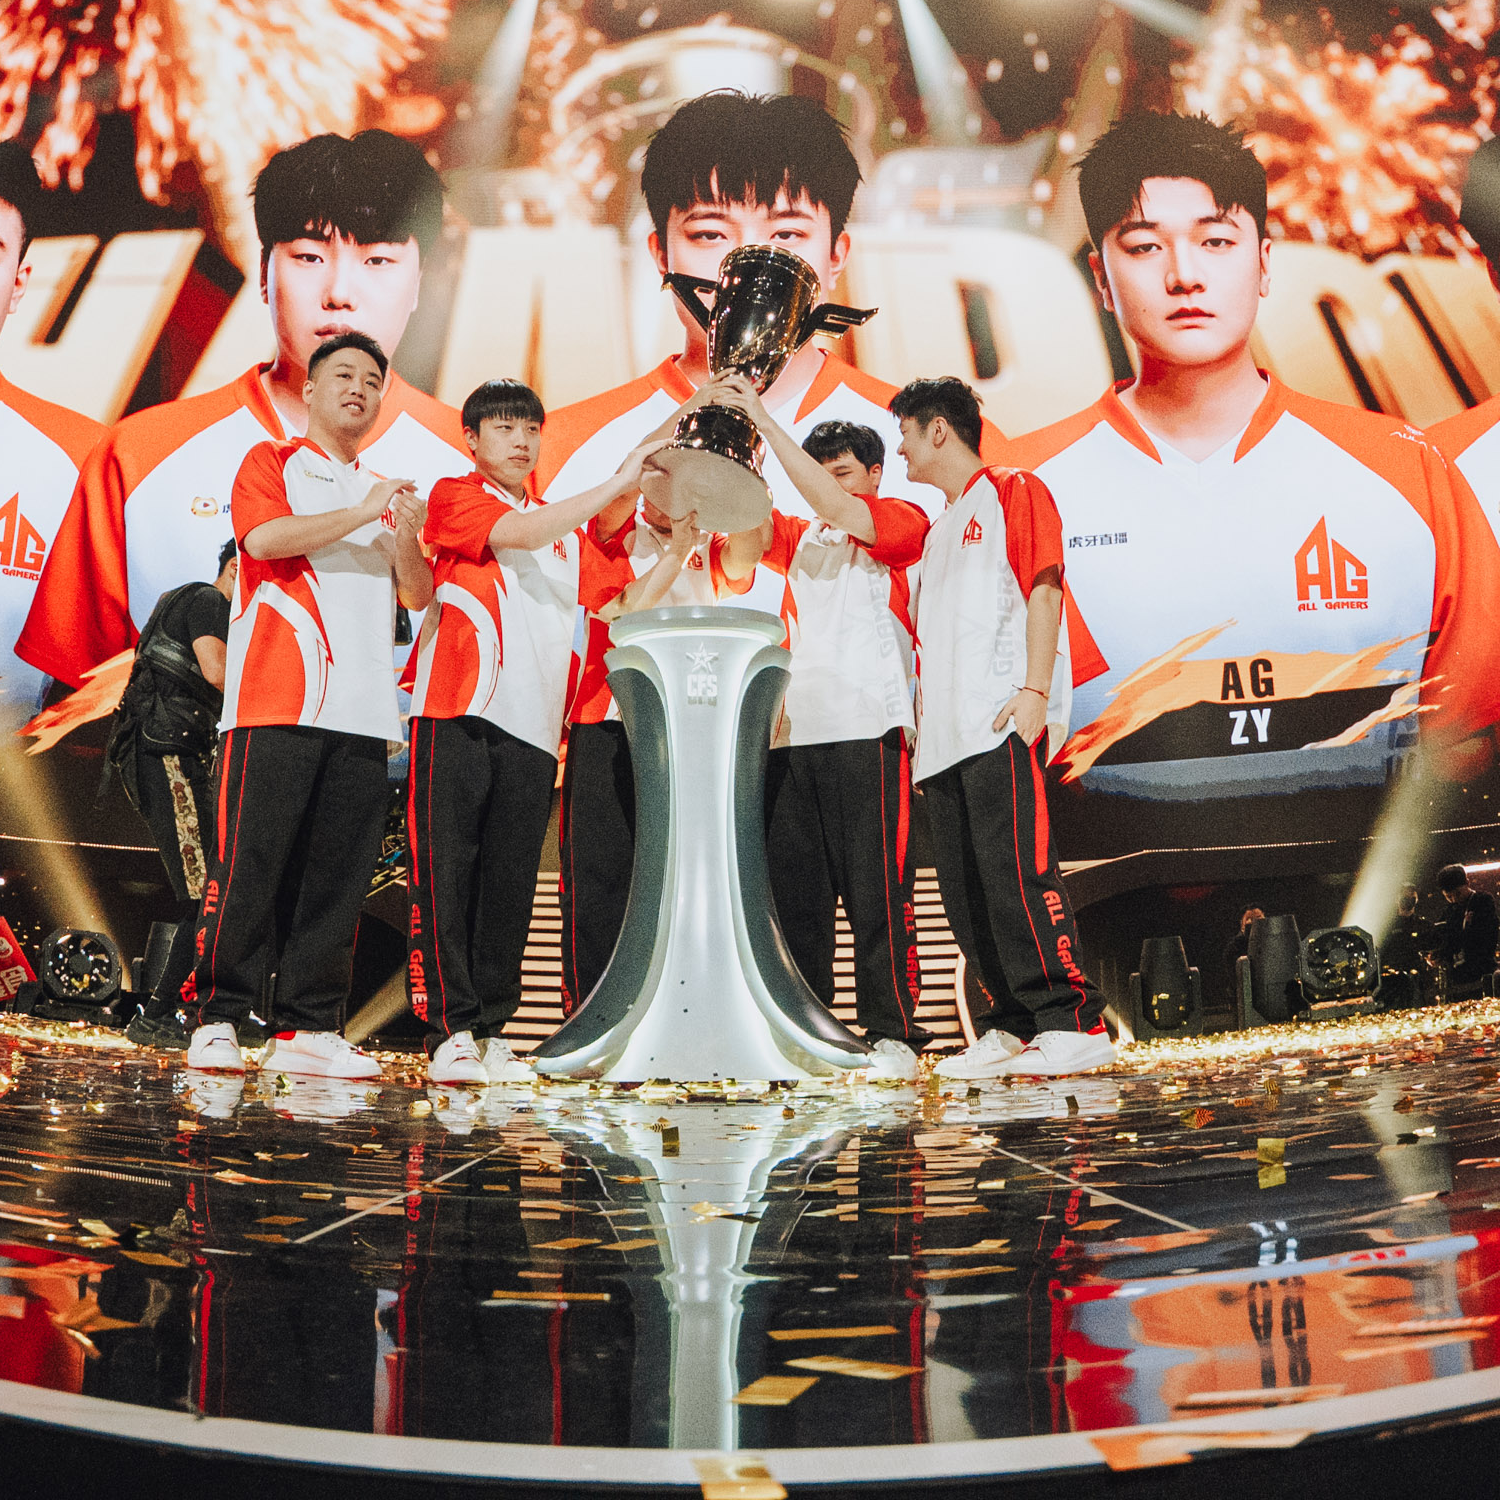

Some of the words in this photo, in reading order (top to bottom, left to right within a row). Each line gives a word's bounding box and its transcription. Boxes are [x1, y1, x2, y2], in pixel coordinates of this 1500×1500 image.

[962, 512, 982, 544] AG
[1068, 532, 1128, 548] 虎牙直播
[2, 568, 41, 581] GAMERS
[1294, 514, 1368, 601] AG
[1297, 602, 1318, 612] ALL
[1325, 600, 1368, 611] GAMERS
[686, 674, 718, 697] CFS
[1221, 658, 1275, 701] AG
[1229, 708, 1272, 745] ZY
[203, 879, 219, 917] ALL
[1042, 890, 1065, 926] ALL
